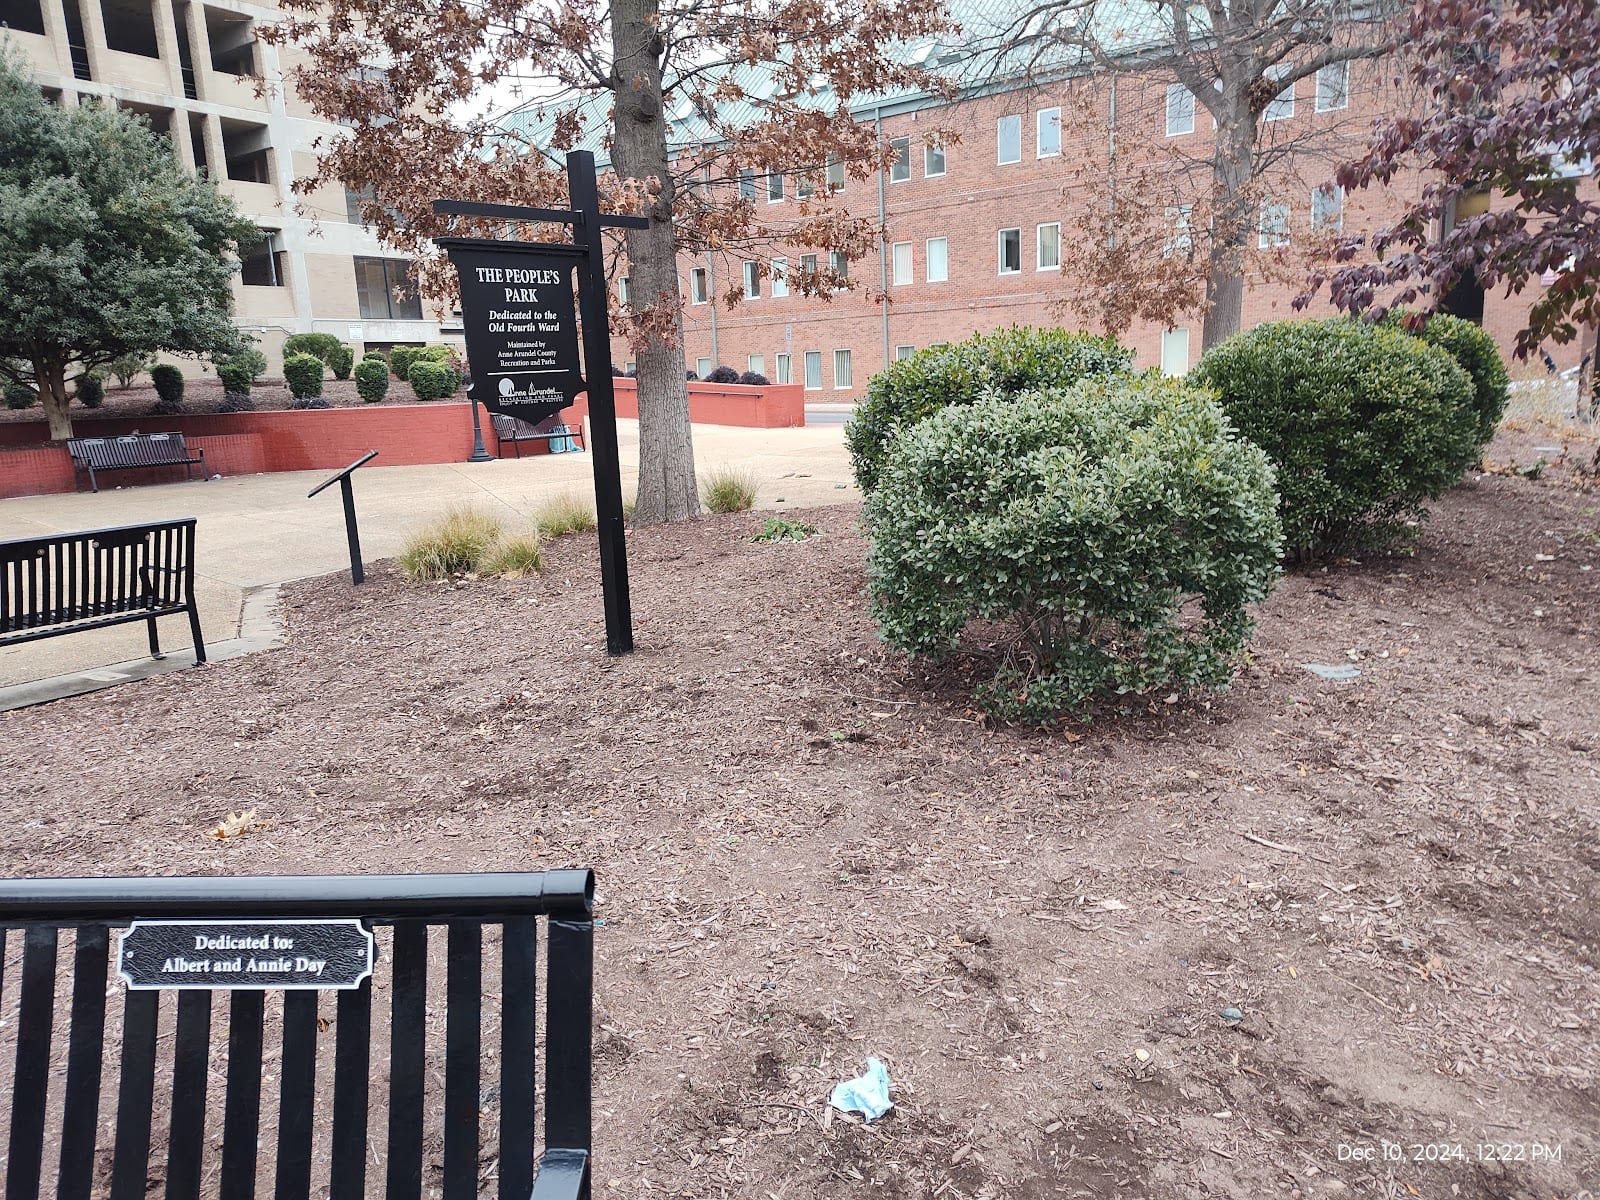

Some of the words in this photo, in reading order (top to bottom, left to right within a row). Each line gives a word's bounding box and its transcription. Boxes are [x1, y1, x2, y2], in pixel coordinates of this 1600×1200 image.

[475, 267, 504, 283] THE
[505, 268, 560, 285] PEOPLE'S
[504, 287, 538, 302] PARK
[489, 310, 532, 320] Dedicated
[534, 310, 543, 320] to
[544, 310, 557, 320] the
[488, 322, 505, 333] Old
[507, 322, 536, 332] Fourth
[538, 322, 560, 332] Ward
[507, 341, 538, 349] Maintained
[539, 340, 546, 350] by
[498, 350, 513, 358] Anne
[514, 349, 537, 357] Arundel
[537, 349, 557, 358] County
[500, 359, 530, 367] Recreation
[530, 358, 541, 366] and
[541, 358, 556, 366] Parks
[194, 934, 270, 950] Dedicated
[273, 935, 294, 950] to:
[161, 957, 210, 973] Albert
[213, 957, 242, 972] and
[246, 957, 292, 972] Annie
[295, 957, 327, 976] Day
